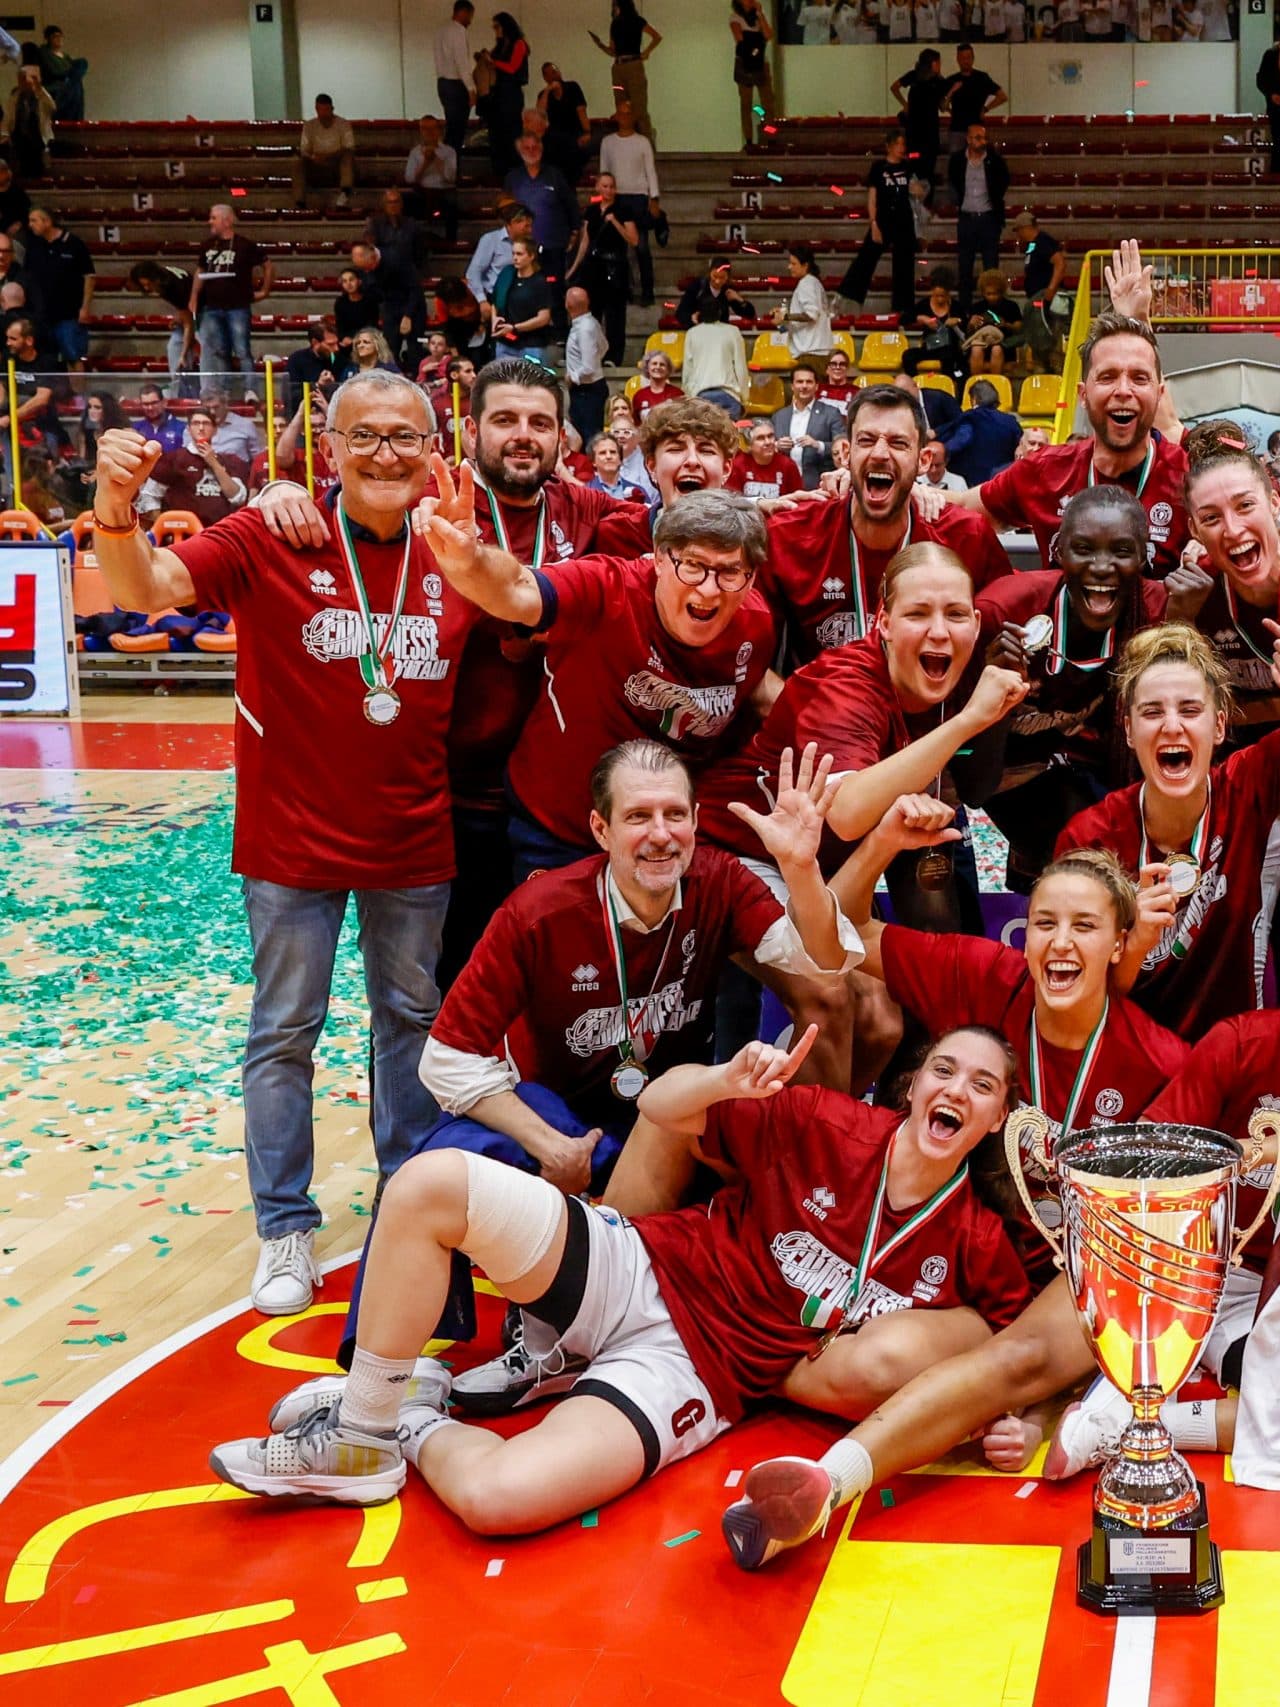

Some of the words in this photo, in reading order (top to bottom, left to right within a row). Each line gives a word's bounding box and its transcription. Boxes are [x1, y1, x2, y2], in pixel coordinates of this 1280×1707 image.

[138, 193, 149, 211] F
[104, 225, 115, 242] F
[823, 592, 846, 600] errea
[572, 982, 600, 992] errea
[802, 1197, 828, 1221] errea
